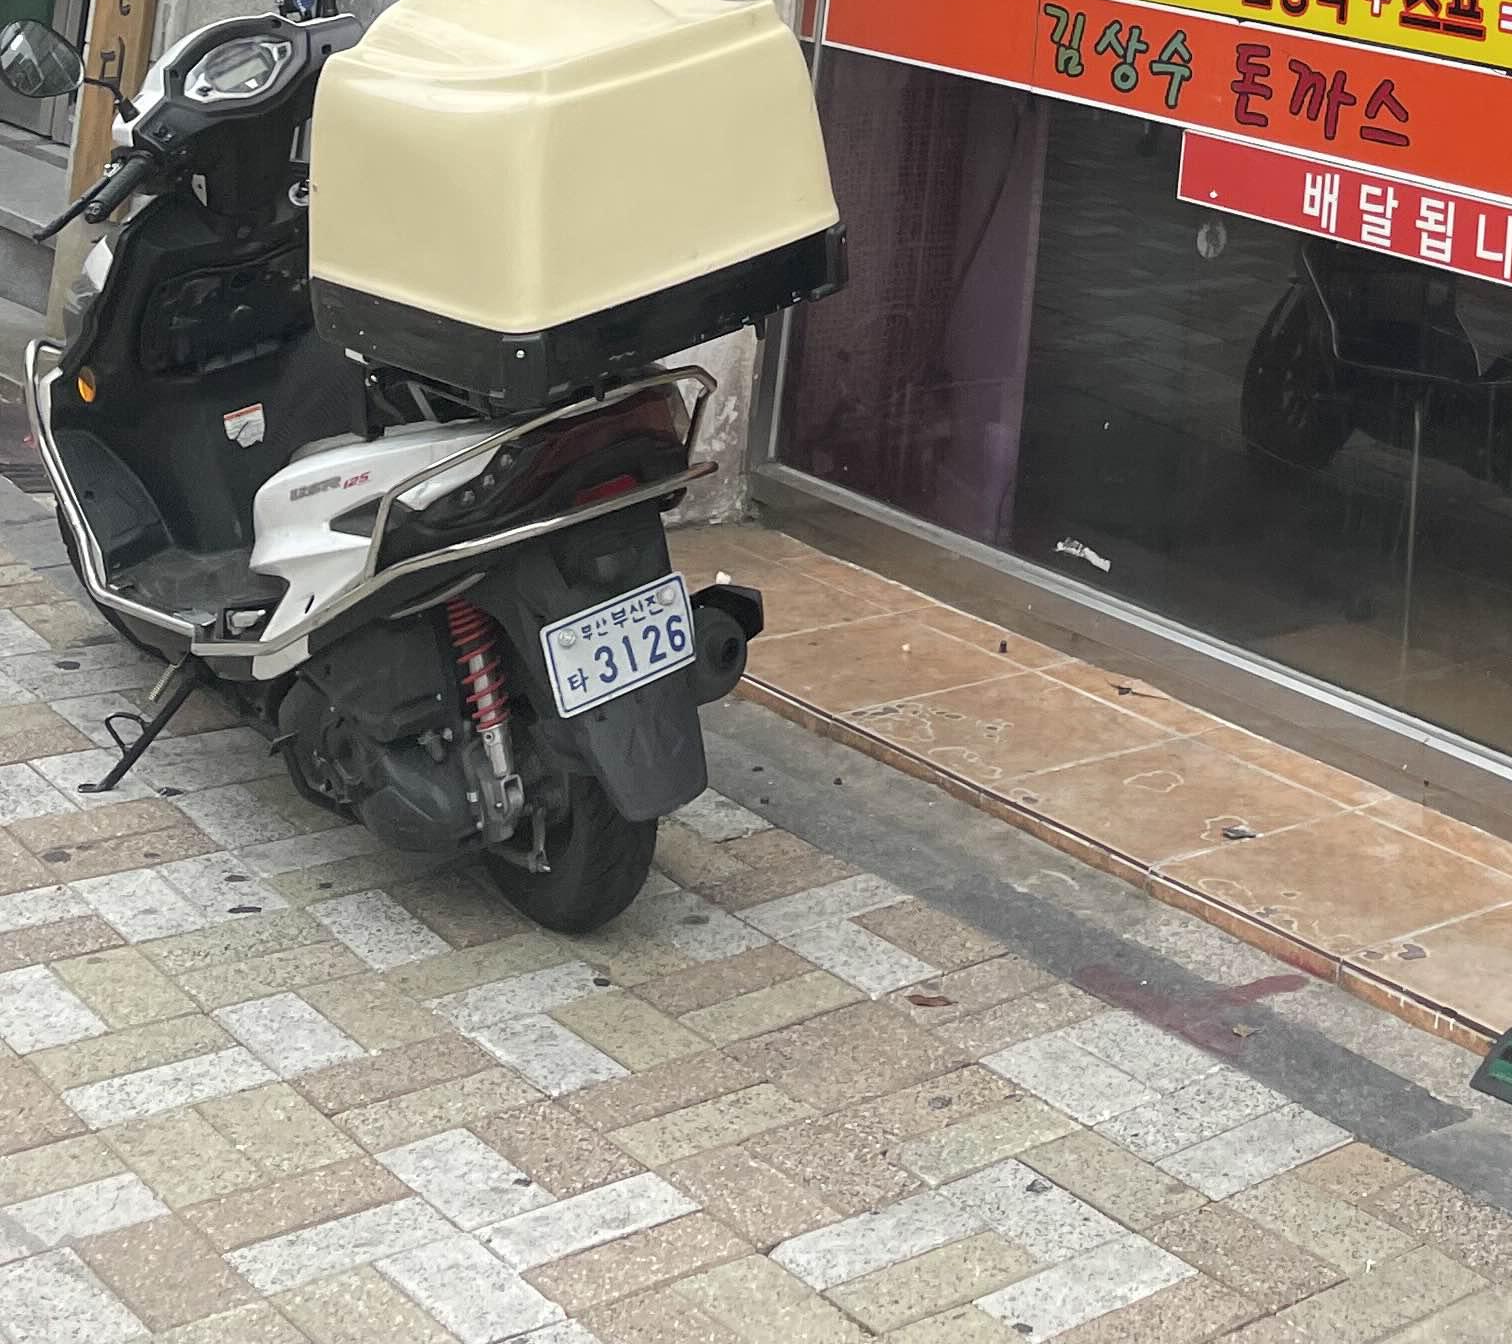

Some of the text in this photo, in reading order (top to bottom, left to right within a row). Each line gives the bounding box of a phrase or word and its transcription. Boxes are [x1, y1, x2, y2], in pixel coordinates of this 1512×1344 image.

[1044, 3, 1410, 147] 김상수 돈까스
[343, 470, 371, 490] 125
[567, 614, 687, 693] 타 3126
[580, 617, 609, 641] 부산
